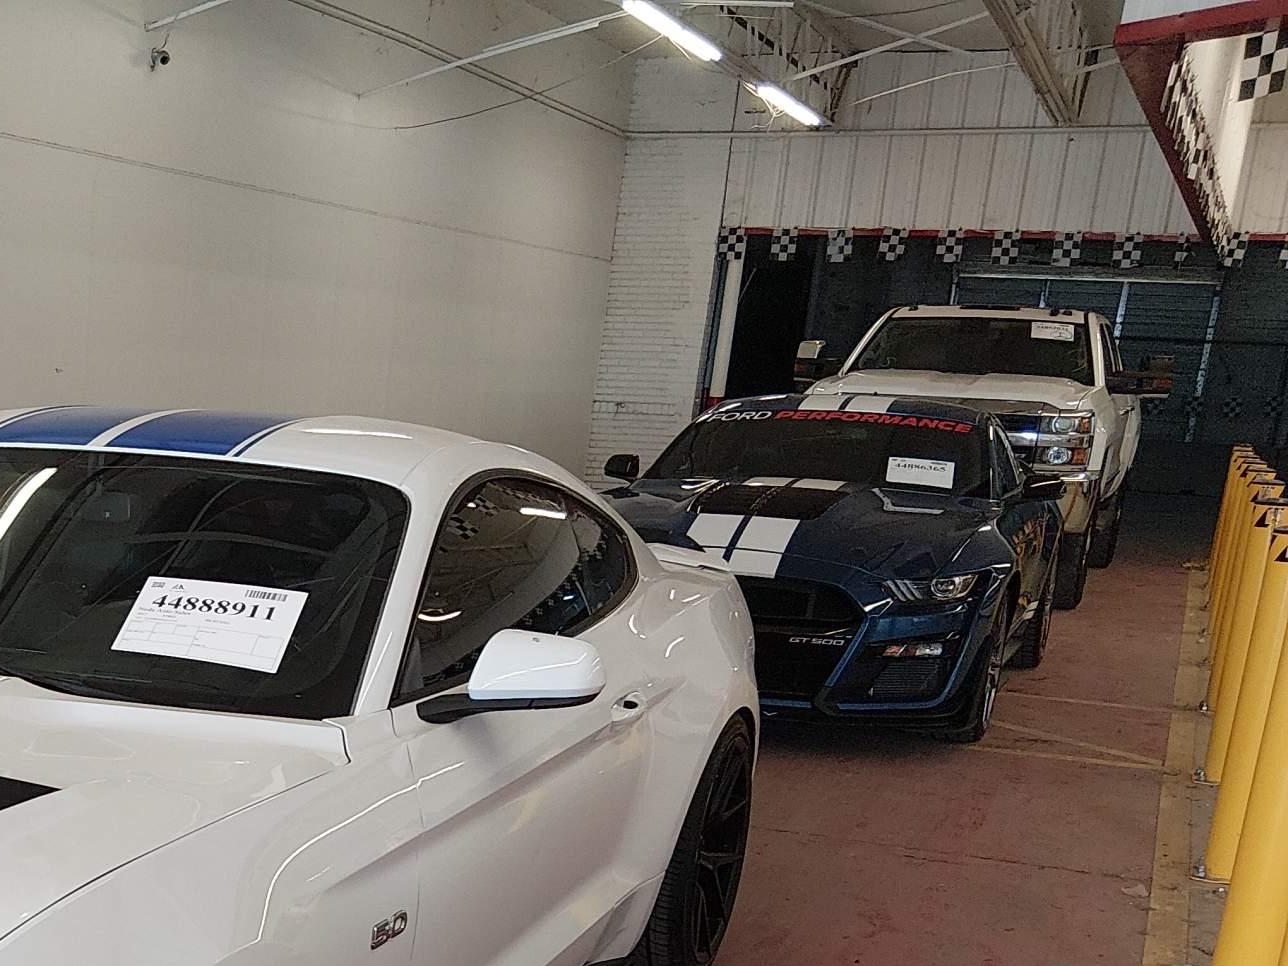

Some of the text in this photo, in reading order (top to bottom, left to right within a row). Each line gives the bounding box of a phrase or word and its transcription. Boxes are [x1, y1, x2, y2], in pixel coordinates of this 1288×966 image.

[709, 409, 974, 434] FORD PERFORMANCE
[151, 594, 278, 622] 44888911
